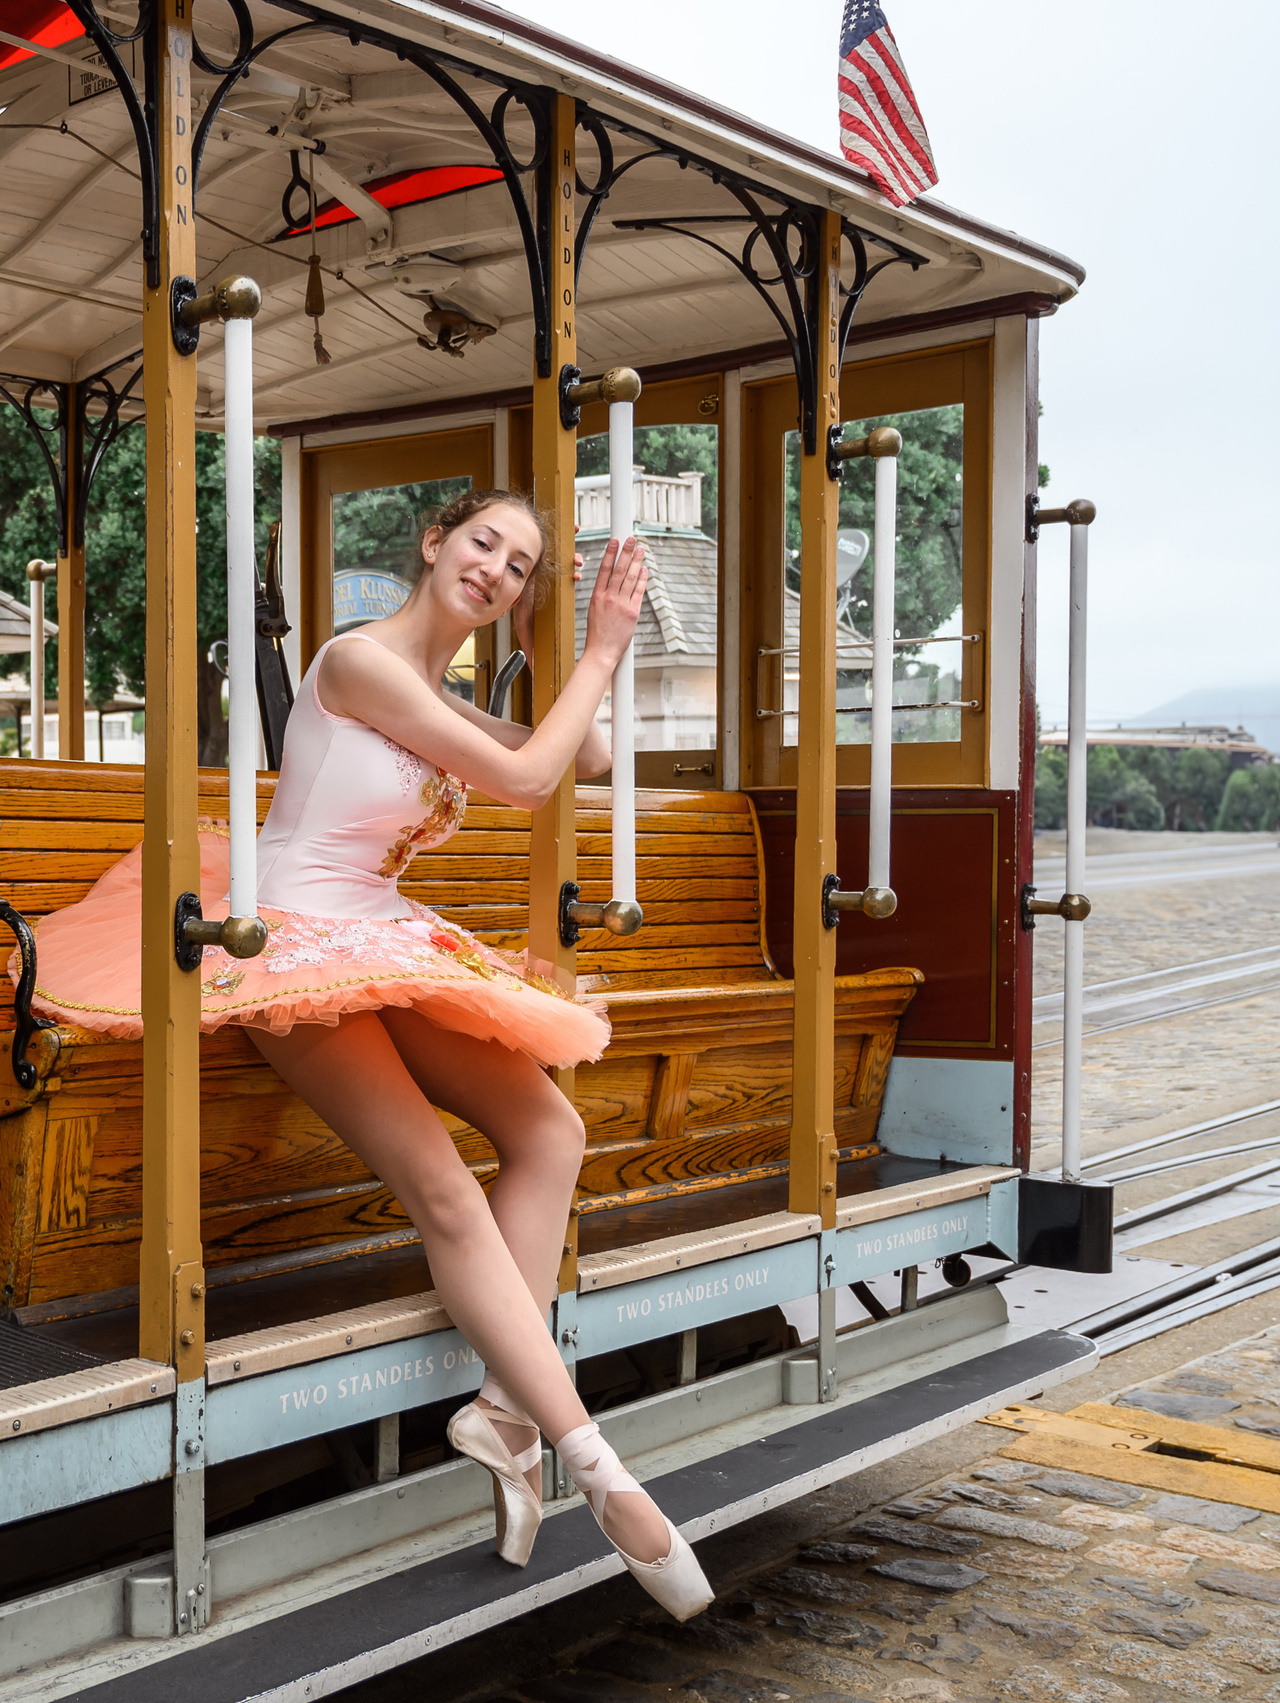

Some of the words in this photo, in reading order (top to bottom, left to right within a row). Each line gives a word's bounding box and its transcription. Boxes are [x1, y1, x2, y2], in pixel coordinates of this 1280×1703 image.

[563, 289, 572, 339] ON
[856, 1238, 882, 1259] TWO
[886, 1223, 938, 1251] STANDEES
[942, 1215, 968, 1236] ONLY
[617, 1298, 652, 1323] TWO
[658, 1277, 729, 1312] STANDEES
[734, 1267, 770, 1291] ONLY
[280, 1385, 328, 1414] TWO
[338, 1356, 434, 1399] STANDEES
